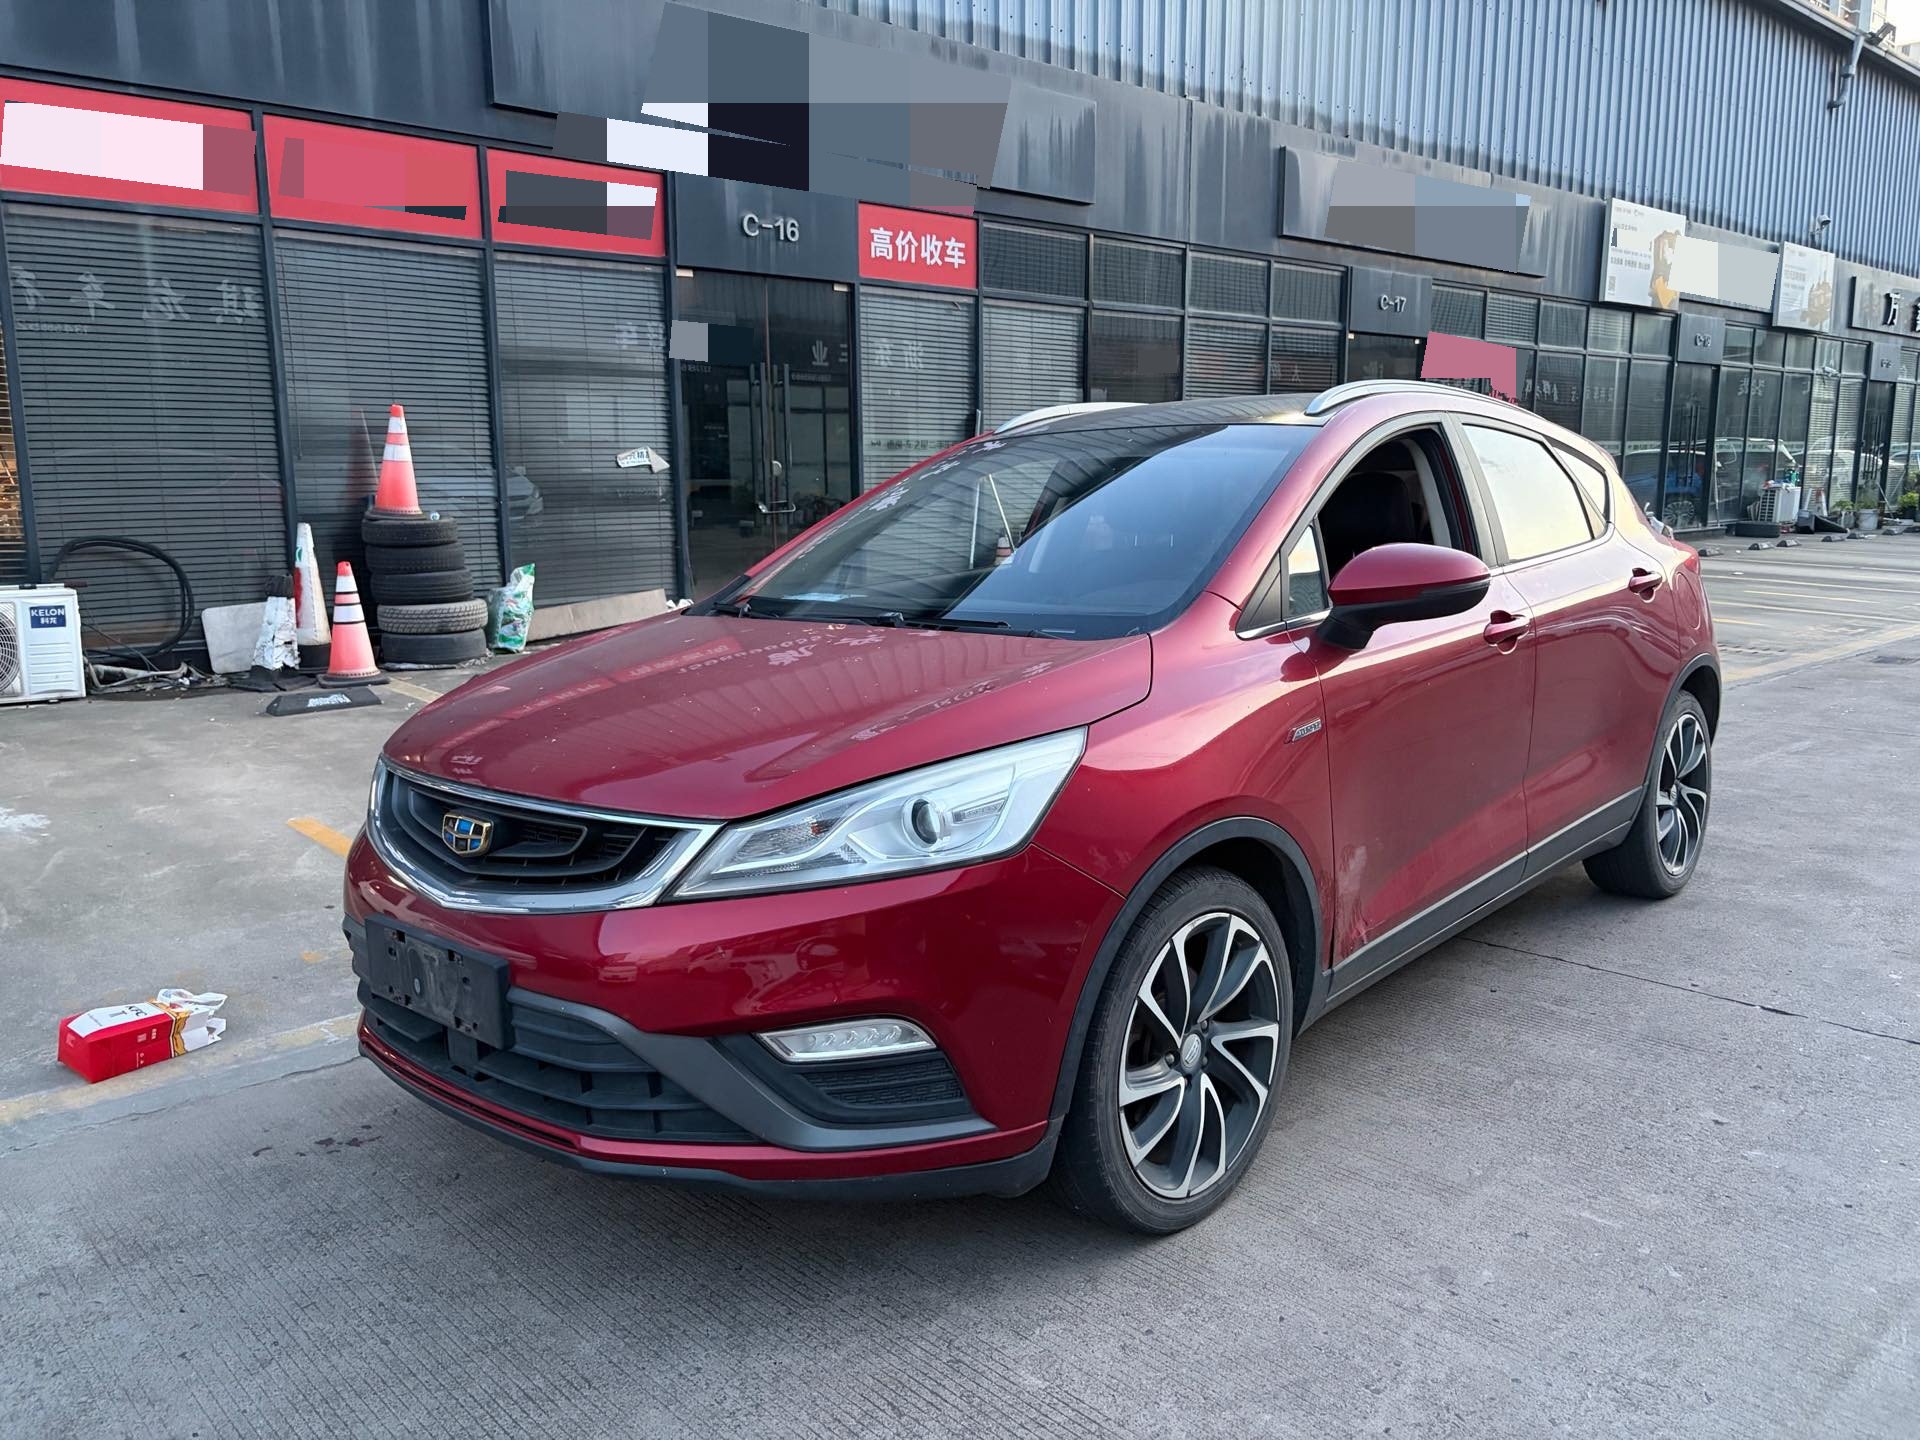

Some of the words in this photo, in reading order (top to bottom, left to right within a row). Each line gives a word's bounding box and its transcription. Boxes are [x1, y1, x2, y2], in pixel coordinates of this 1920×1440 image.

[743, 213, 799, 241] C-16
[870, 227, 966, 269] 高价收车
[1380, 294, 1407, 312] C-17
[31, 608, 65, 617] KELON
